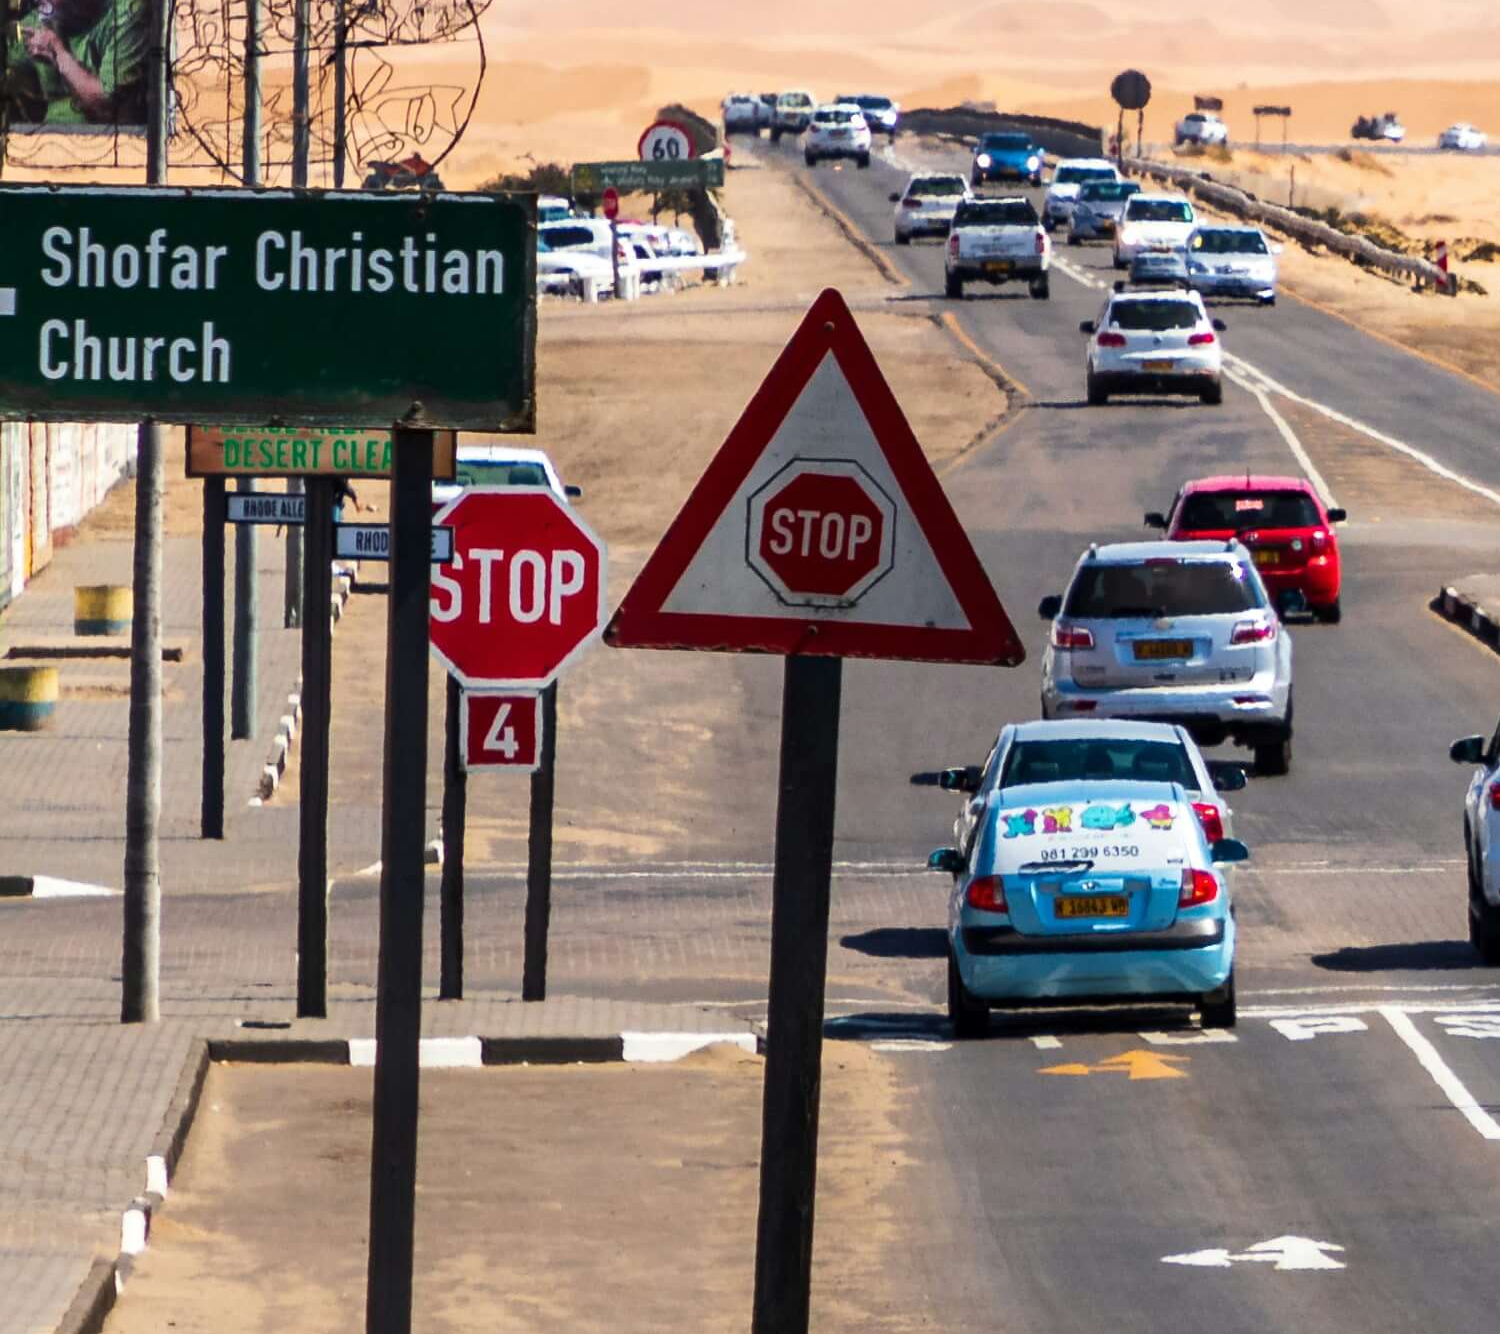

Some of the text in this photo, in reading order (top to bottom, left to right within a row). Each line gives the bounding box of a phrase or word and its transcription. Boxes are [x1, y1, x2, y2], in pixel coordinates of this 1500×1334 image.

[652, 137, 680, 161] 60
[41, 226, 504, 294] Shofar Christian
[39, 318, 231, 383] Church
[224, 439, 392, 471] DESERT CLEA
[243, 500, 277, 517] RHODE
[769, 508, 872, 560] STOP
[431, 548, 586, 625] STOP
[483, 703, 519, 759] 4
[1041, 848, 1066, 861] 081
[1103, 845, 1139, 857] 6350
